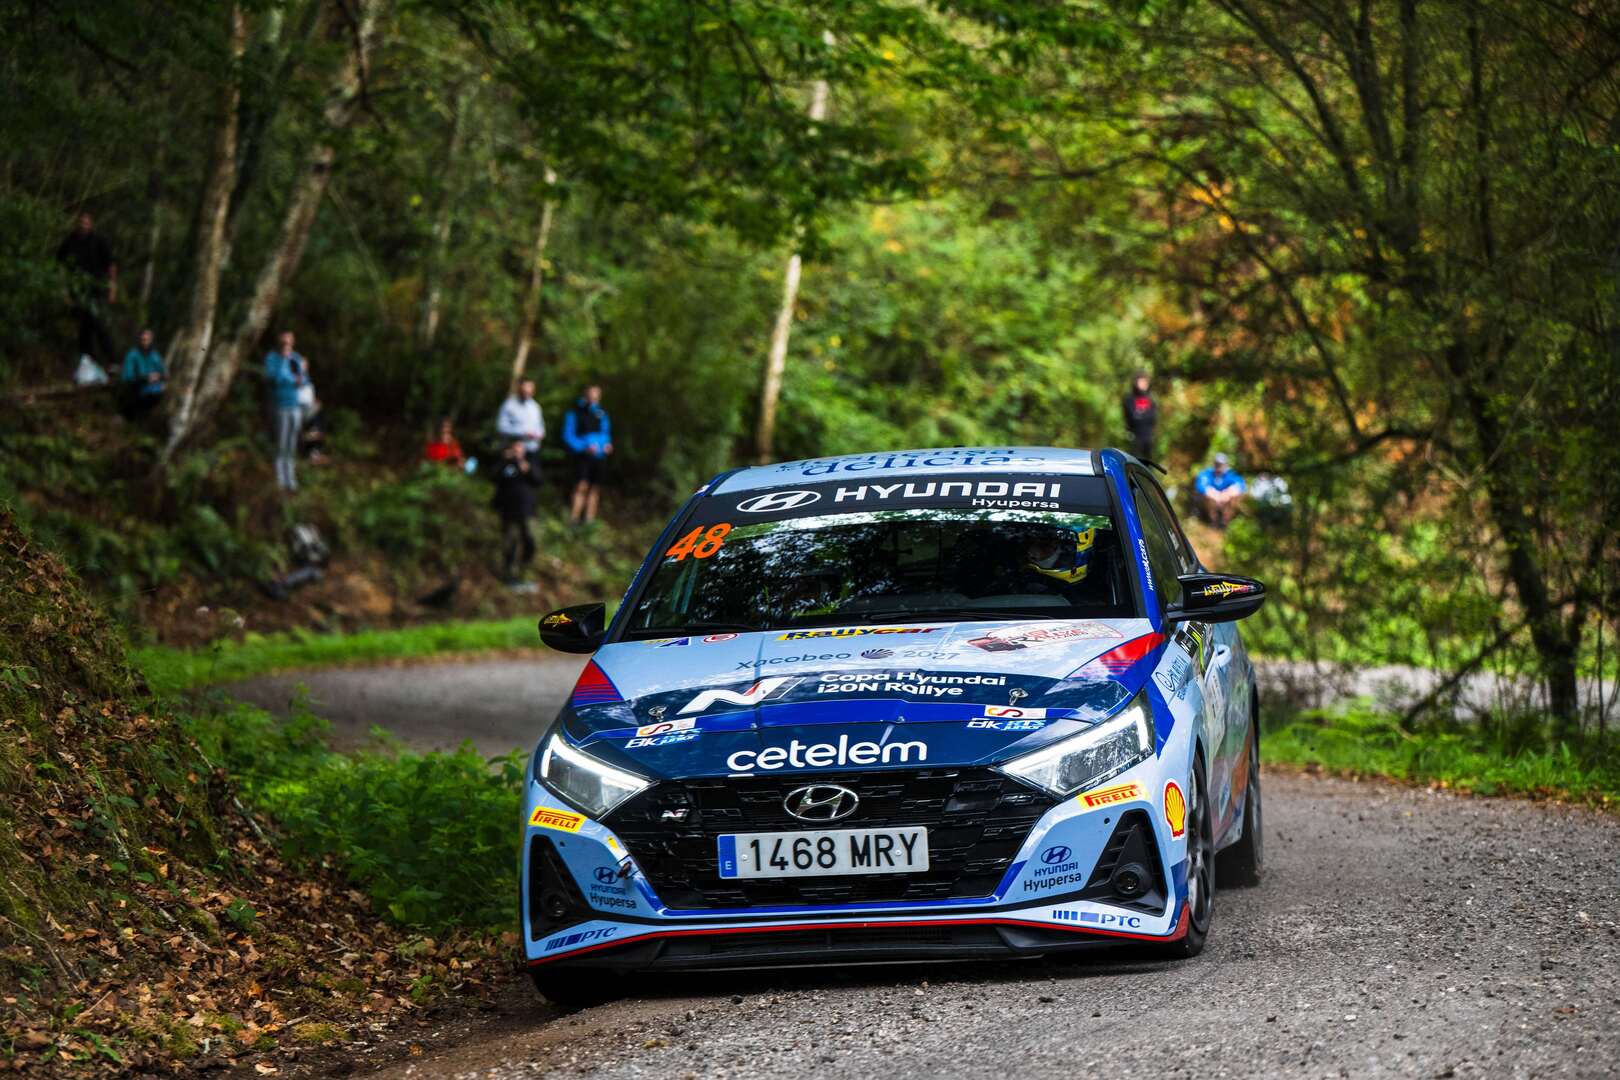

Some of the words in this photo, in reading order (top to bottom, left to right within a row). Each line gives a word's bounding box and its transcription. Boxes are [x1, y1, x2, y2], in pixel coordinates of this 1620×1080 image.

[802, 454, 1045, 476] delicias
[834, 481, 1061, 502] HYUNDAI
[972, 498, 1060, 509] Hyupersa
[665, 523, 731, 560] 48
[785, 627, 942, 641] Rallycar
[735, 652, 852, 670] xacobeo
[903, 650, 960, 660] 2027
[820, 673, 890, 683] Copa
[896, 672, 1006, 686] Hyundai
[817, 682, 880, 693] i20N
[885, 683, 963, 697] Rallye
[727, 734, 928, 771] cetelem
[533, 810, 580, 829] PIRELLI
[750, 837, 836, 872] 1468
[850, 832, 919, 868] MRY
[724, 860, 737, 870] E
[1034, 862, 1078, 877] HYUNDAI
[1024, 872, 1082, 892] Hyupersa
[589, 892, 637, 909] Hyupersa
[1101, 913, 1141, 928] PTC
[581, 927, 618, 942] PTC
